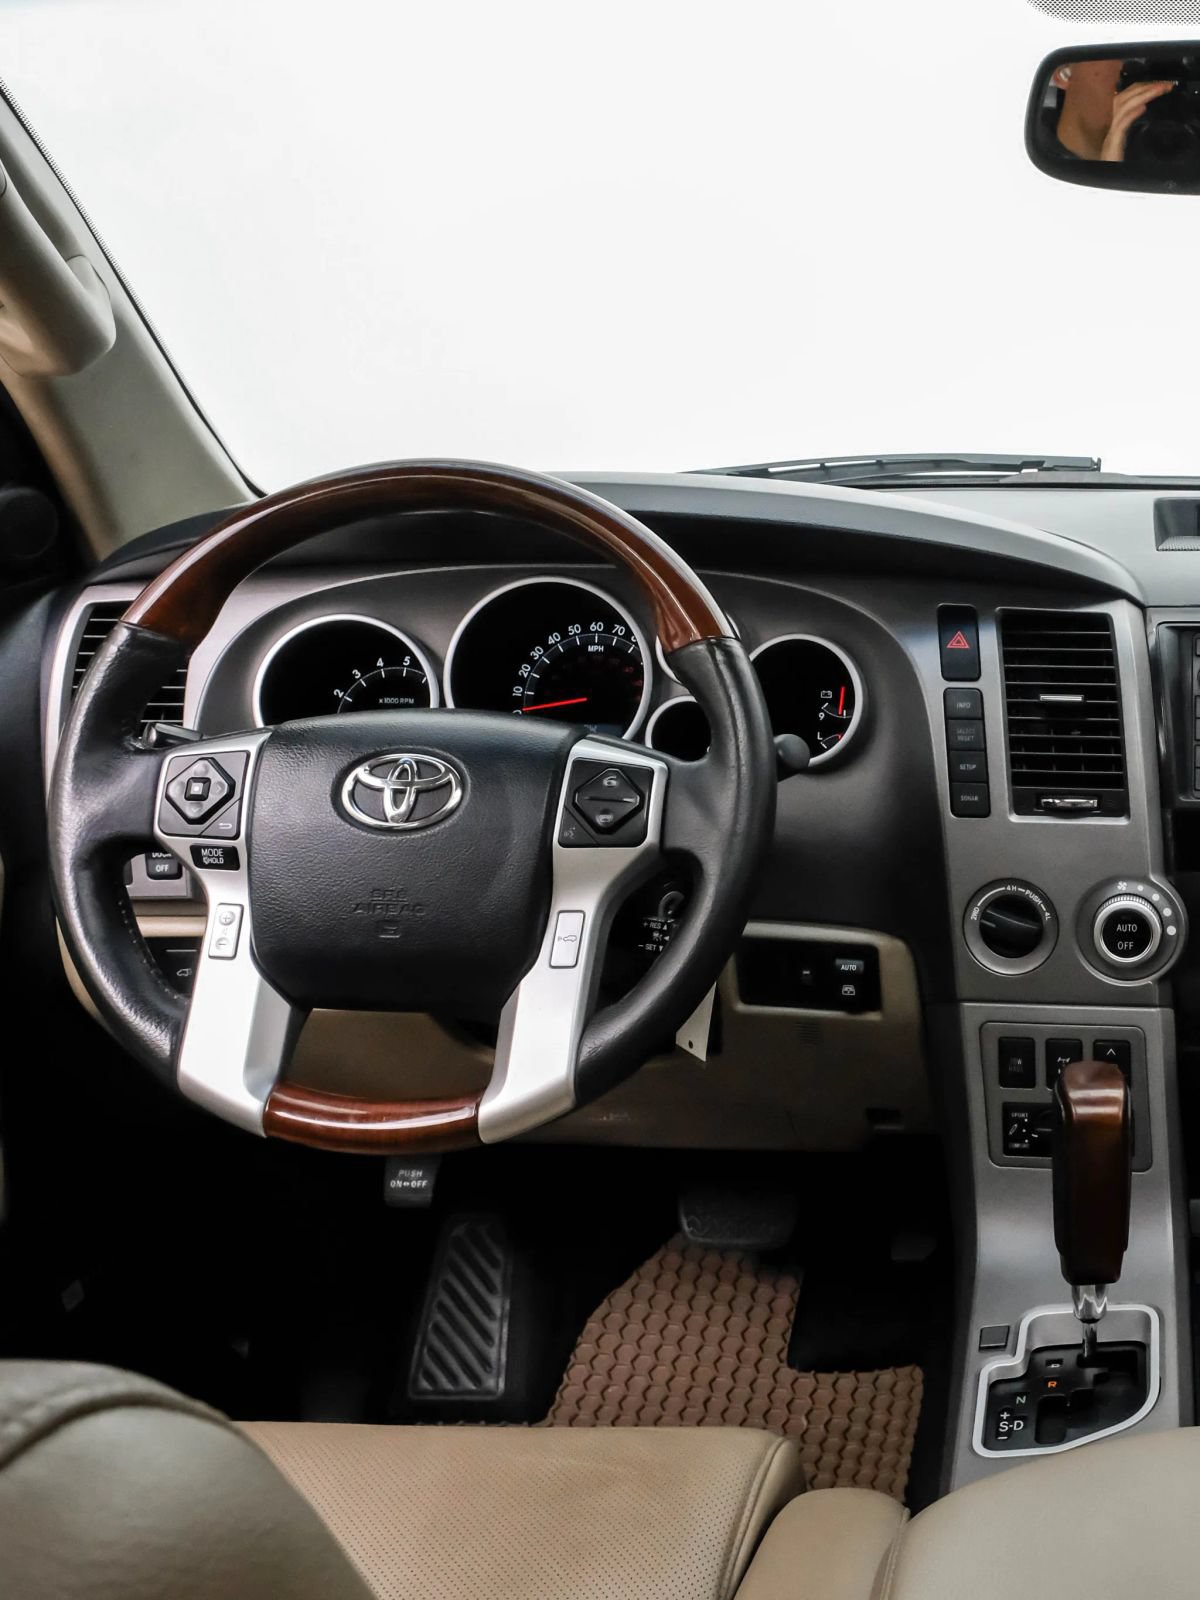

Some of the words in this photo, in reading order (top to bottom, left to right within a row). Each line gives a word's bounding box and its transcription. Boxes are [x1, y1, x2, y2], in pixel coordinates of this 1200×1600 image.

[567, 623, 582, 636] 50
[589, 621, 604, 632] 60
[611, 623, 626, 636] 70
[547, 632, 561, 645] 40
[529, 645, 544, 660] 30
[587, 645, 604, 653] MPH
[376, 657, 384, 668] 4
[403, 655, 411, 666] 5
[352, 669, 362, 679] 3
[518, 663, 531, 679] 20
[333, 688, 345, 699] 2
[512, 685, 524, 697] 10
[818, 712, 825, 721] 9
[959, 763, 977, 771] SETUP
[201, 848, 224, 857] MODE
[155, 864, 169, 872] OFF
[1006, 884, 1017, 892] 4H
[1024, 889, 1042, 905] PUSH
[1044, 911, 1052, 921] 4L
[1116, 924, 1138, 933] AUTO
[645, 943, 657, 951] SET
[1117, 941, 1135, 950] OFF
[398, 1169, 423, 1177] PUSH
[390, 1180, 403, 1188] ON
[410, 1180, 428, 1188] OFF
[1047, 1380, 1057, 1388] R
[1016, 1395, 1026, 1404] N
[998, 1420, 1024, 1433] S-D
